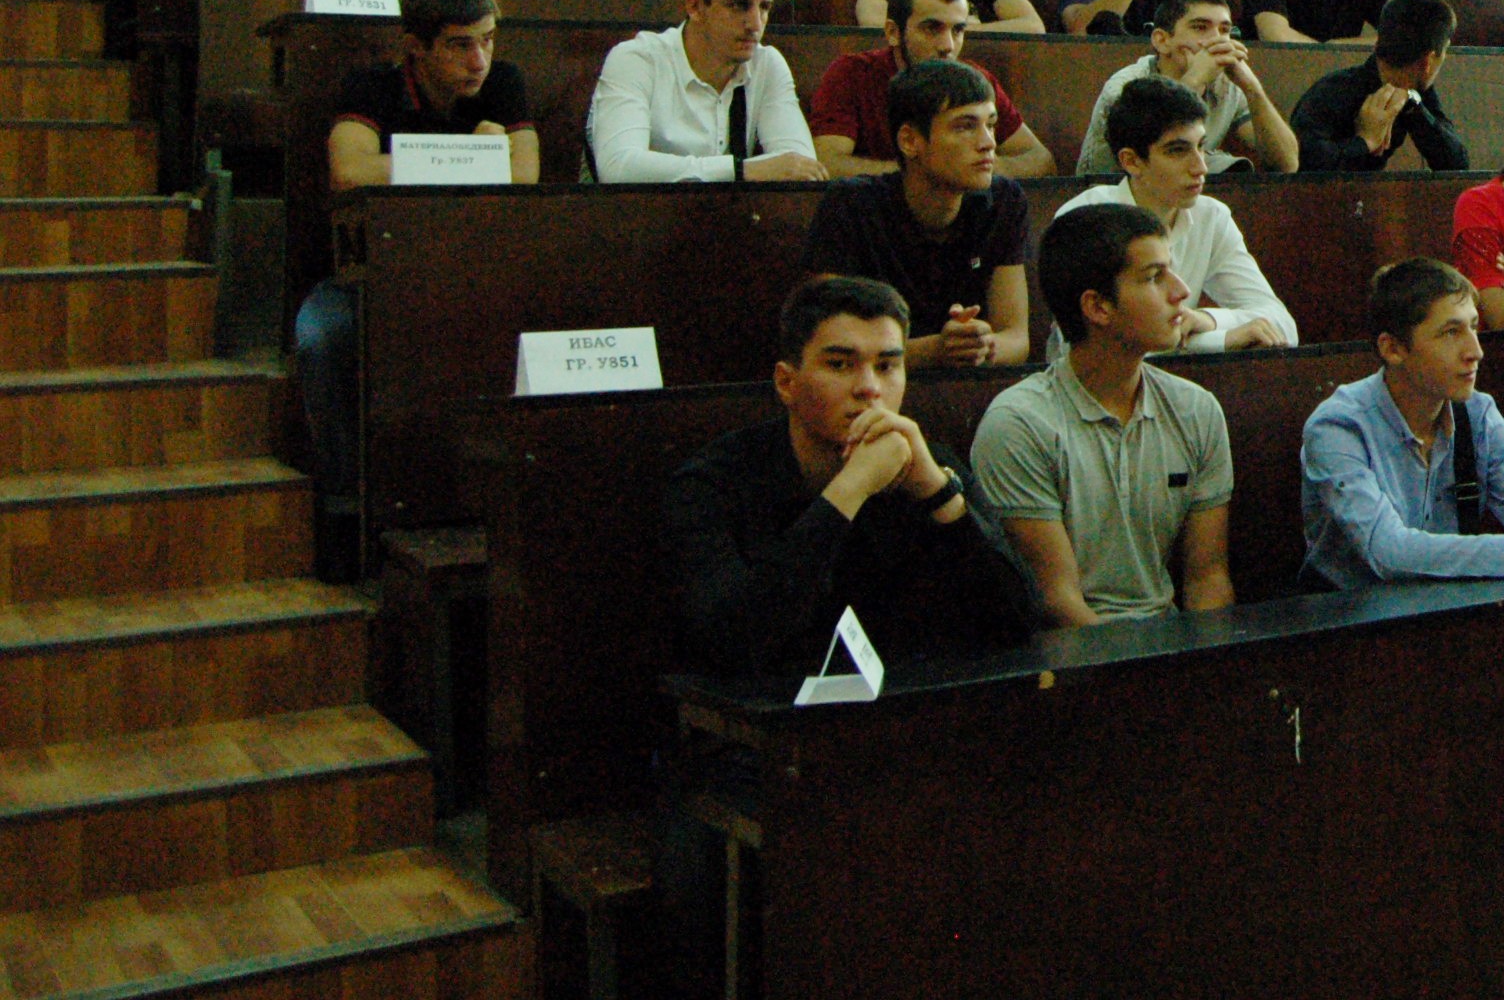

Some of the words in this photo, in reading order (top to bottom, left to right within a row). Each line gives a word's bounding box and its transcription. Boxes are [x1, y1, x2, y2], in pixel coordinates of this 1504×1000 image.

[358, 0, 386, 10] У831
[399, 142, 504, 151] МАТЕРИАЛОВЕДЕНИЕ
[569, 335, 617, 350] ИБАС
[565, 358, 592, 371] ГР.
[597, 355, 639, 369] У851
[1286, 706, 1301, 764] 1
